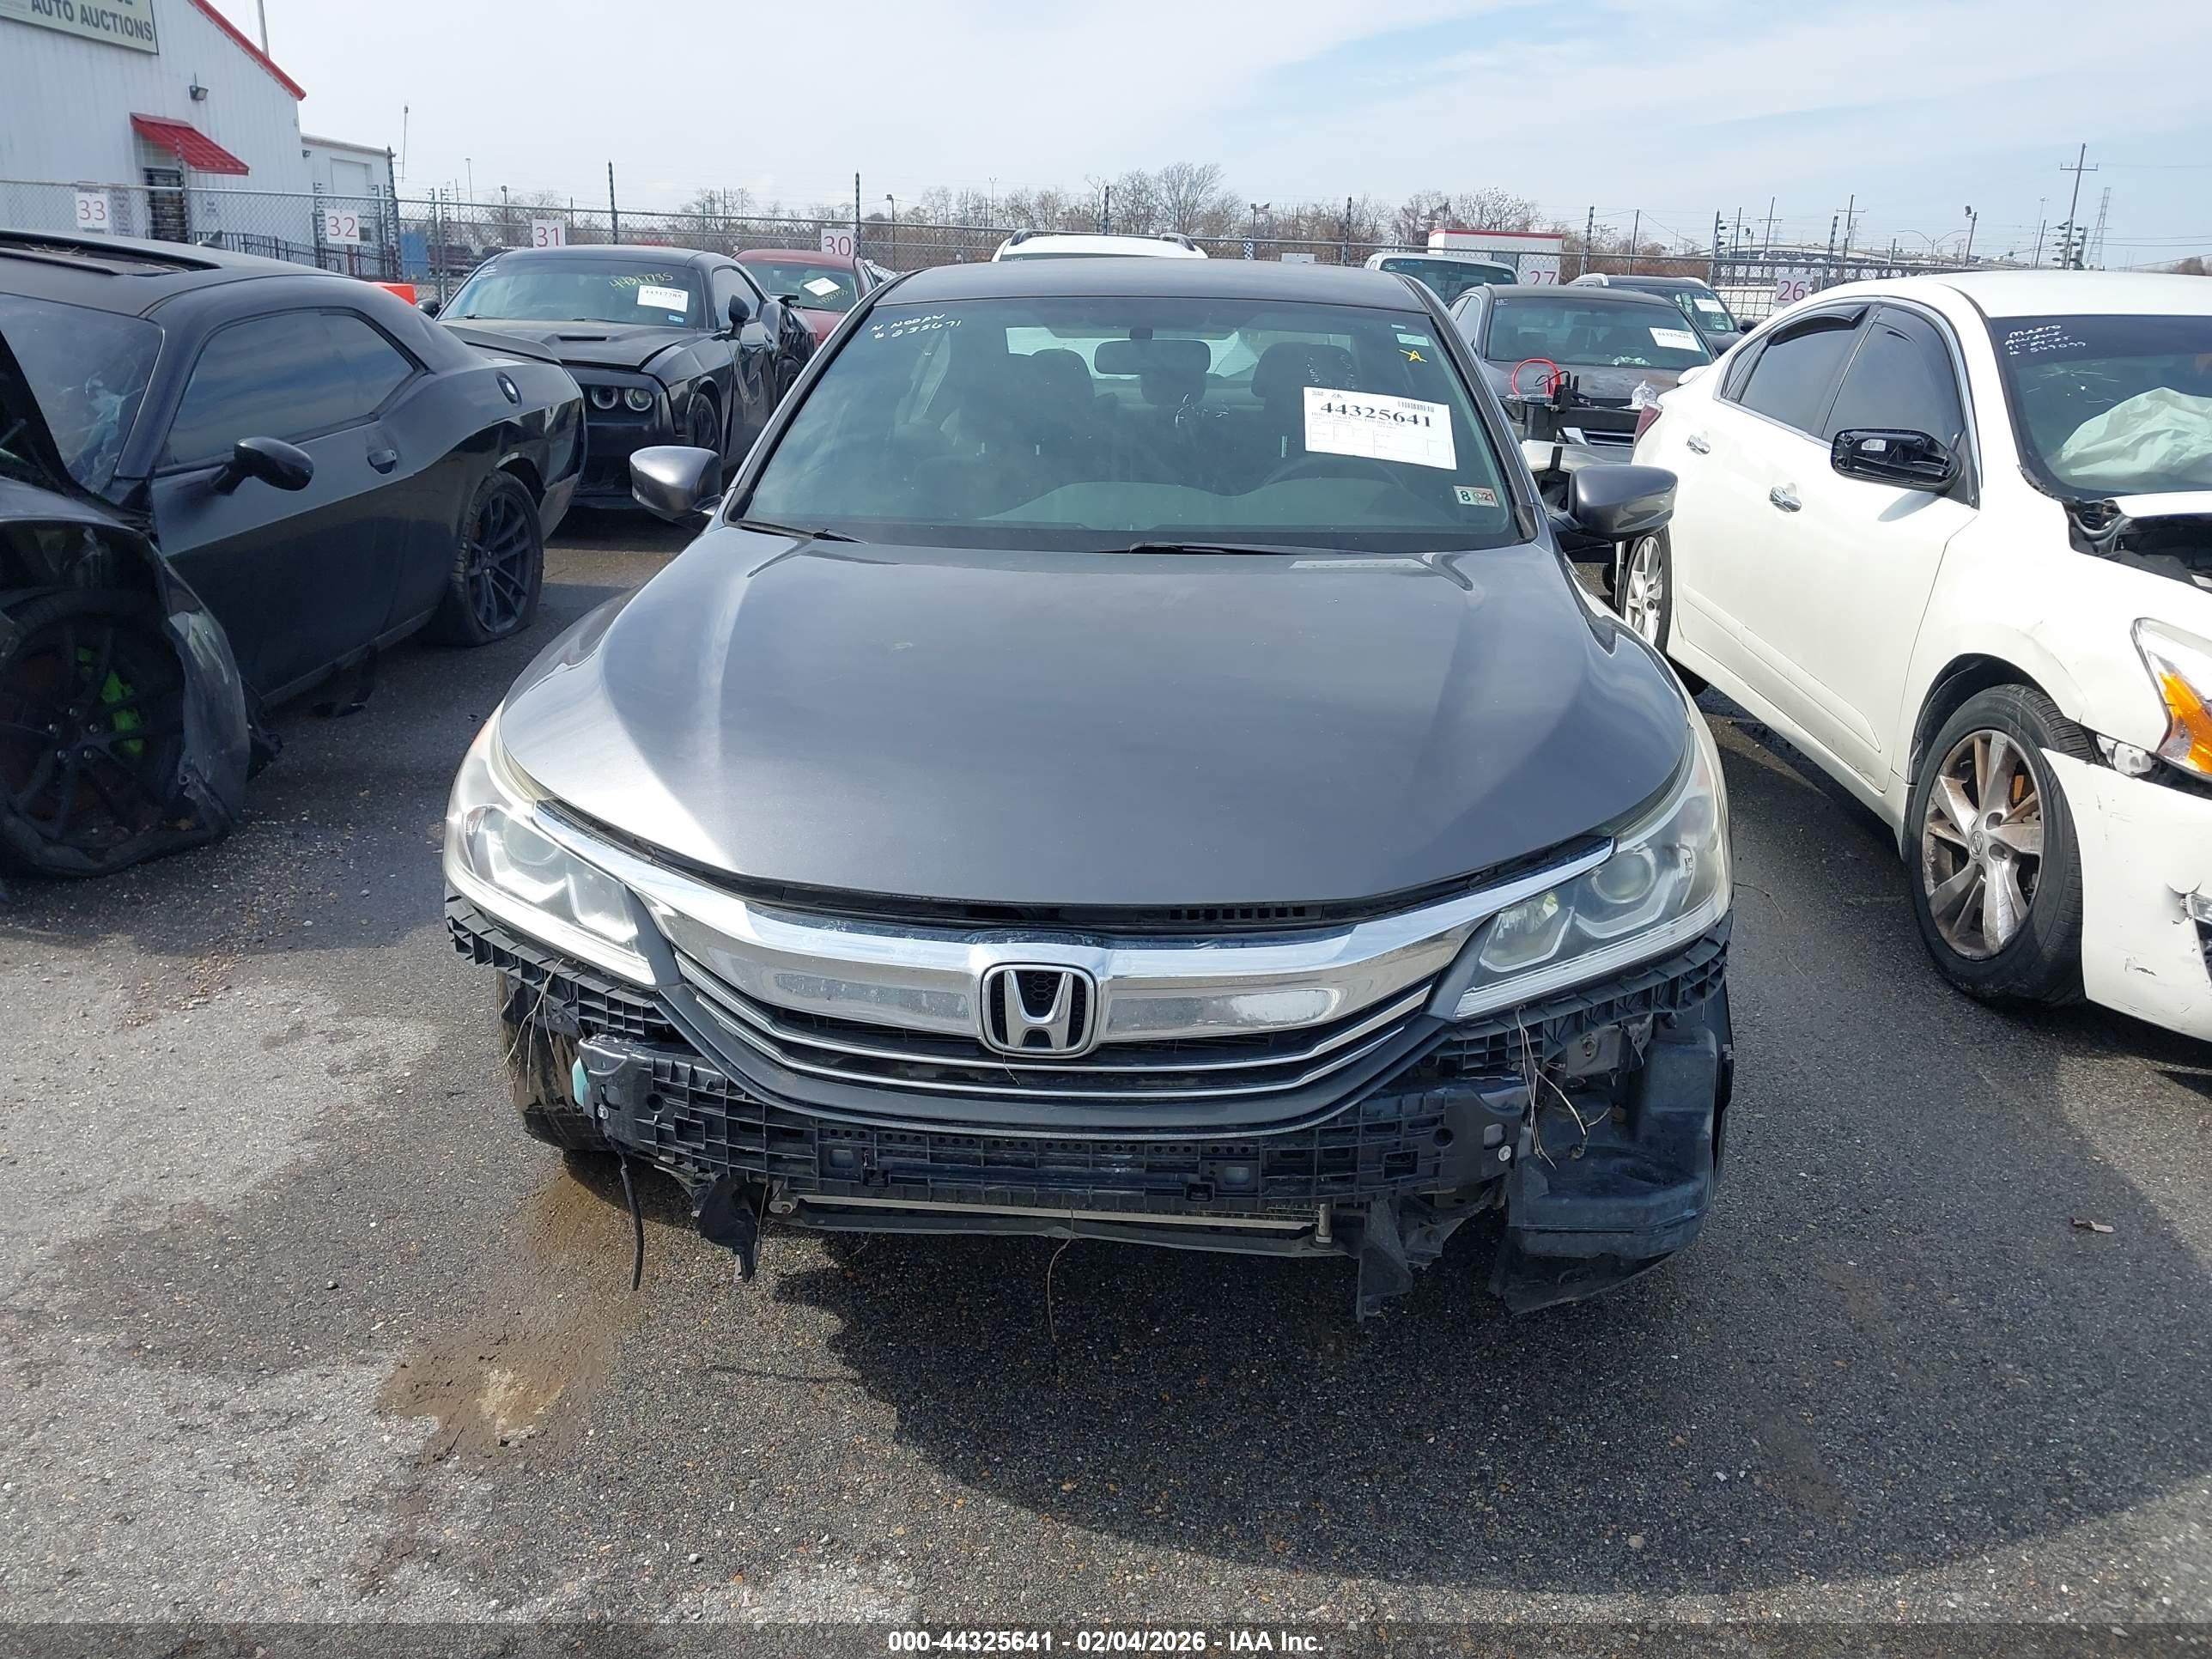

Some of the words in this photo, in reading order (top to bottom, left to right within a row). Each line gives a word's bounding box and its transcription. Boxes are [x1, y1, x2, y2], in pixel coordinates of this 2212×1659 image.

[31, 0, 75, 22] AUTO
[80, 4, 154, 42] AUCTIONS
[77, 199, 106, 222] 33
[328, 216, 357, 239] 32
[536, 226, 561, 247] 31
[823, 235, 852, 256] 30
[1528, 270, 1557, 285] 27
[1778, 280, 1807, 301] 26
[1320, 402, 1431, 428] 44325641
[1460, 490, 1471, 501] 8
